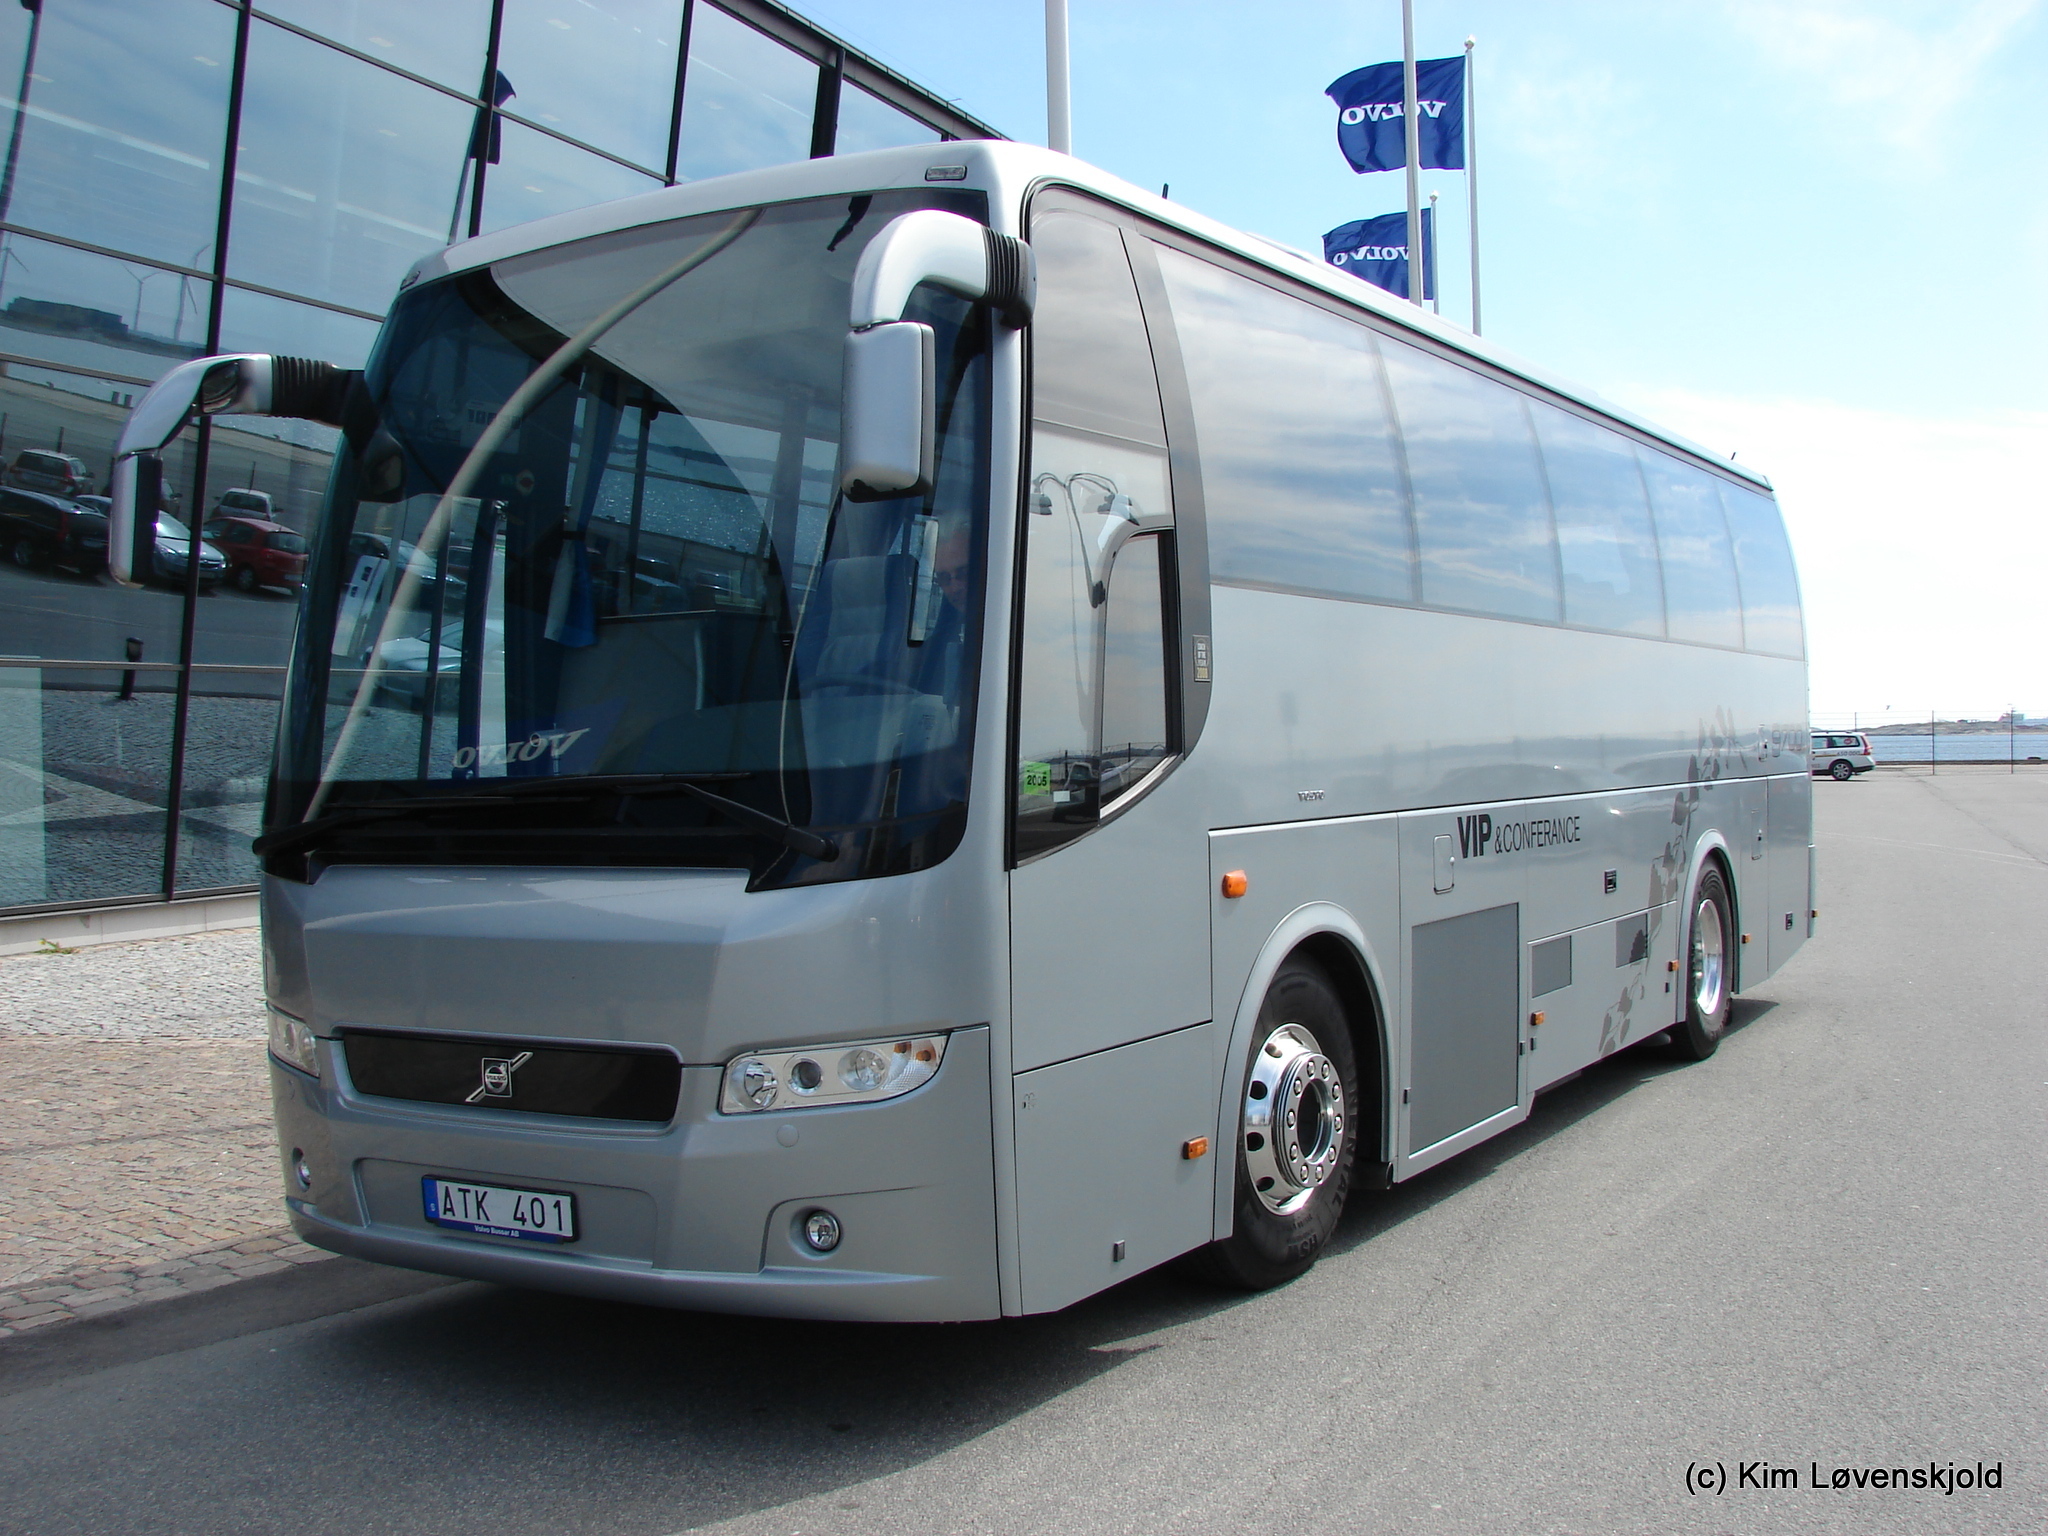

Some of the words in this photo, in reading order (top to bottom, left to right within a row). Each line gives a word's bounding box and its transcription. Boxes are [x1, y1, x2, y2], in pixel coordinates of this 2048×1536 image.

[1457, 814, 1492, 858] VIP
[442, 1185, 491, 1222] ATK
[513, 1194, 563, 1232] 401
[474, 1225, 490, 1233] Volvo
